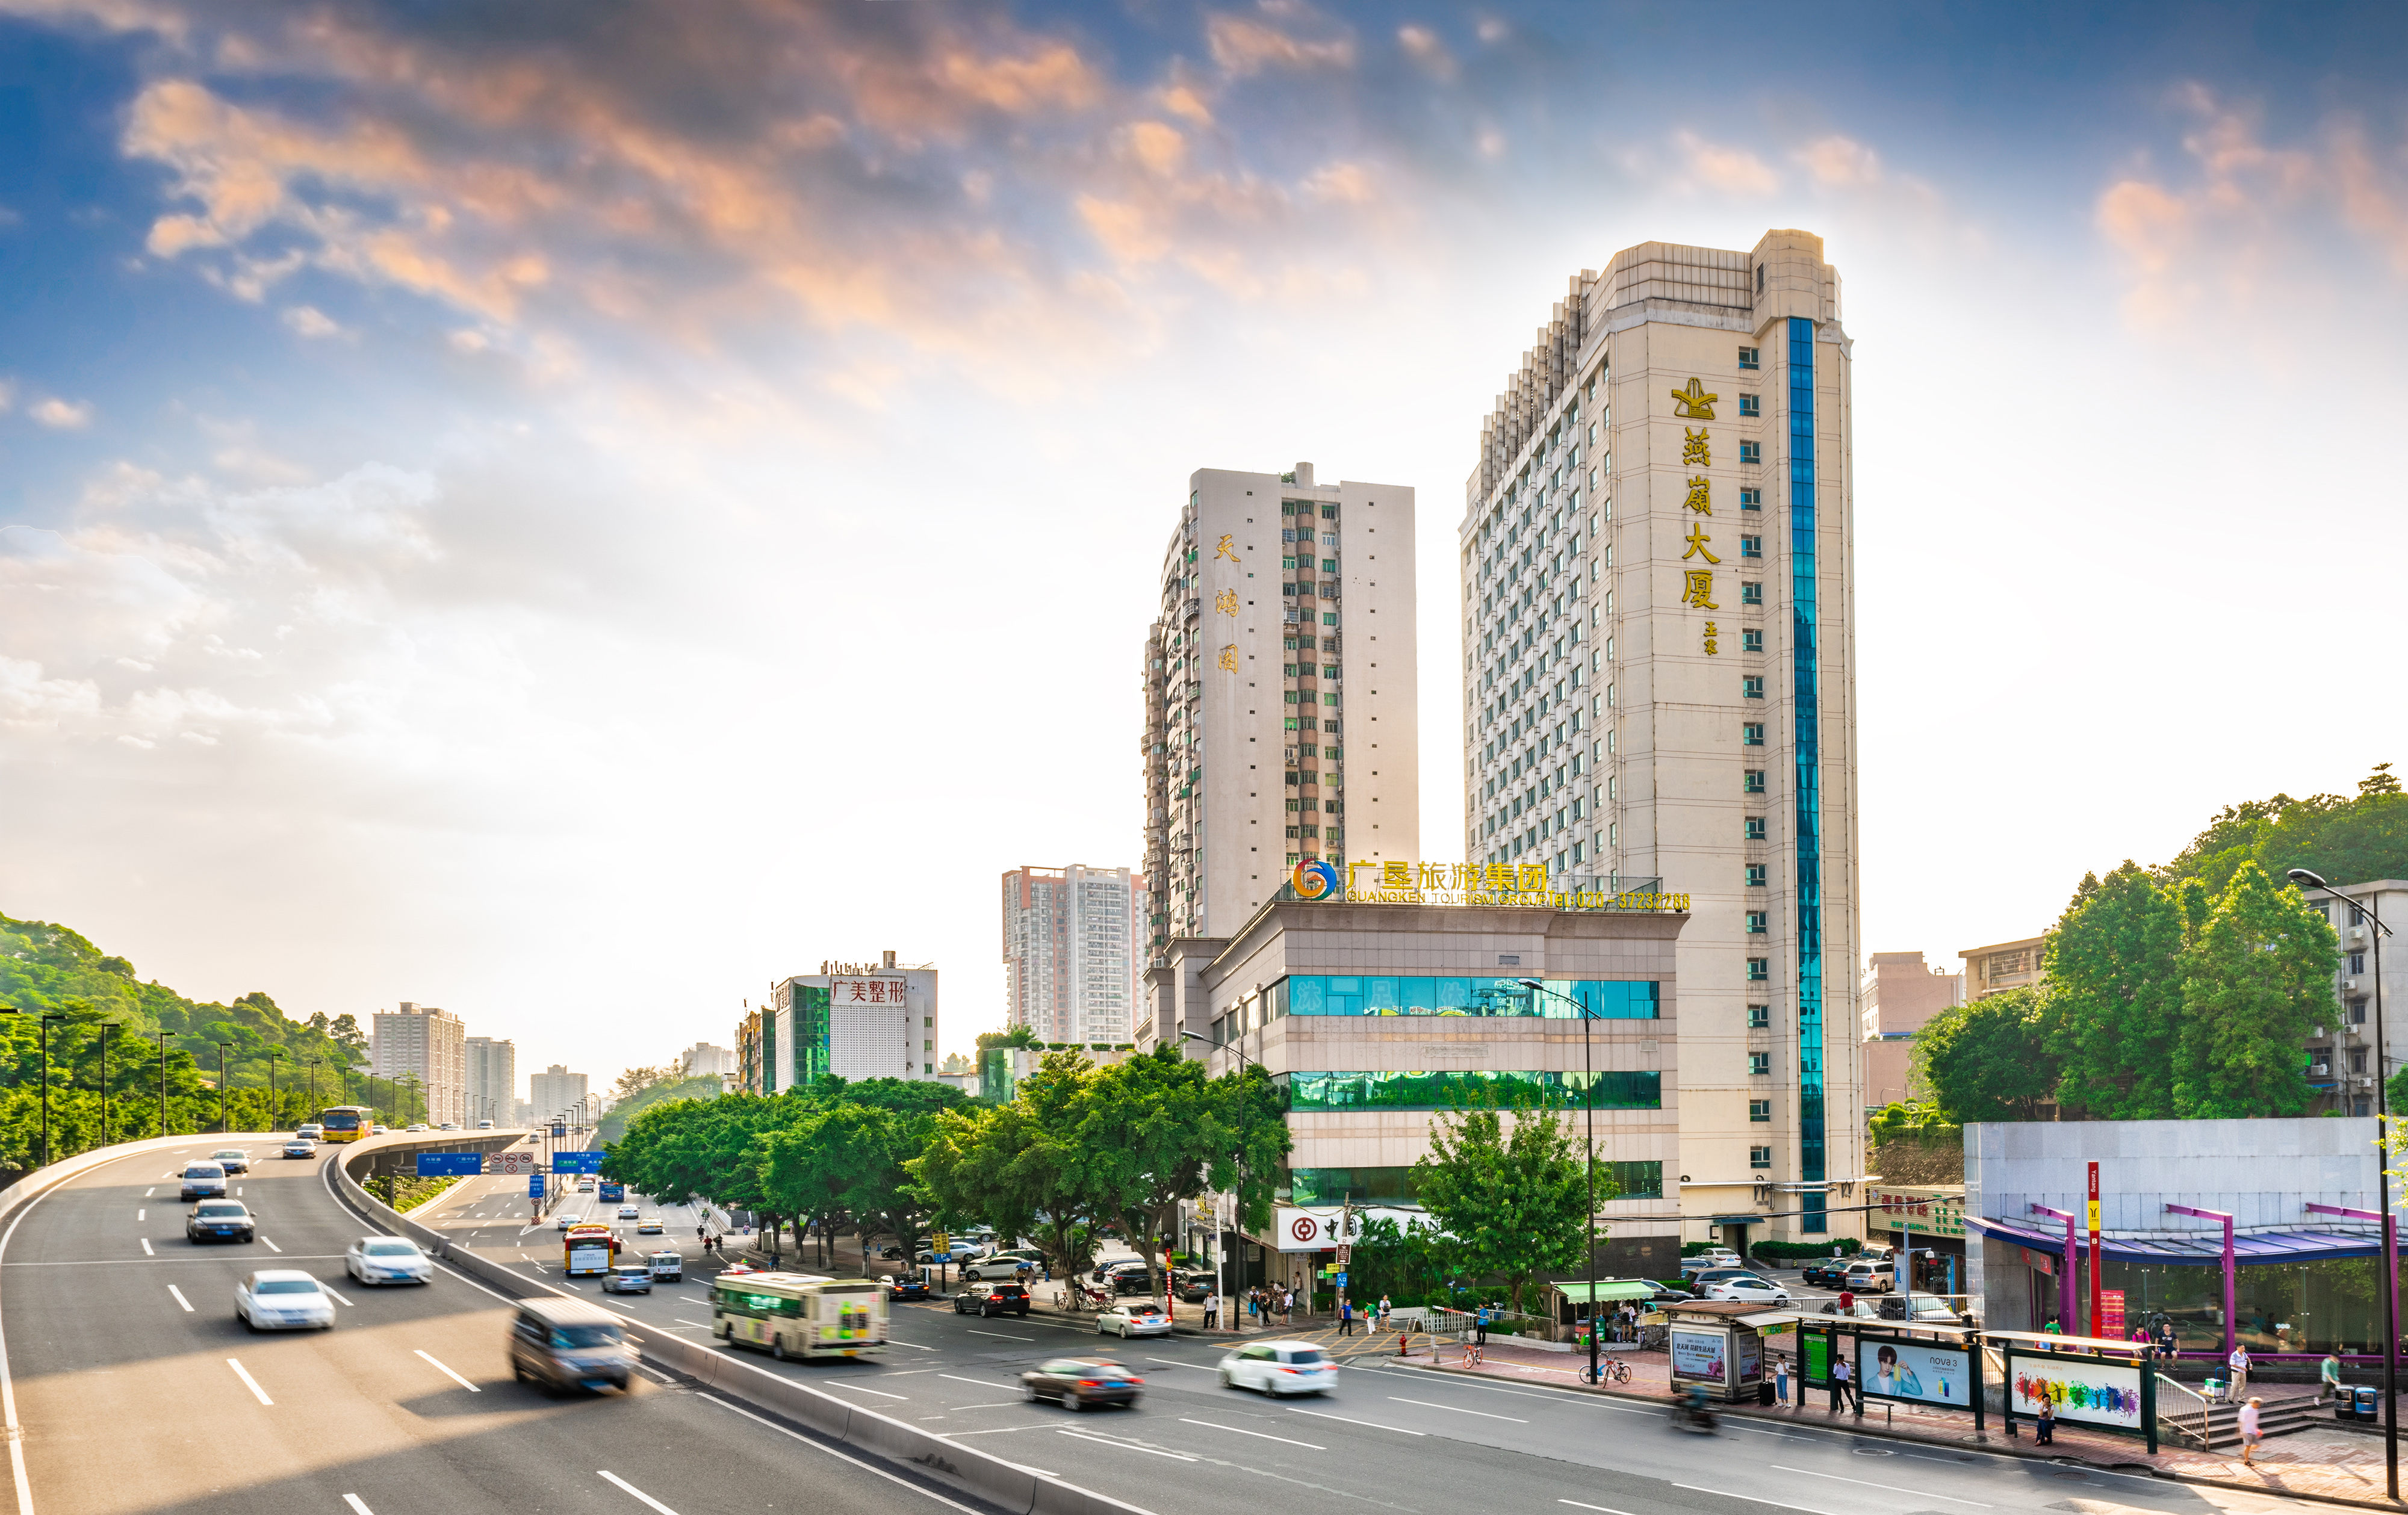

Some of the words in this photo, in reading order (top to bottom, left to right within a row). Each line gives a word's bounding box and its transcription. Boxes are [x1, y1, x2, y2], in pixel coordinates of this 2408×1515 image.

[1346, 859, 1547, 892] 广垦旅游集团
[1346, 890, 1426, 902] GUANGKEN
[1432, 892, 1494, 904] TOURISM
[1498, 893, 1547, 906] GROUP
[831, 979, 904, 1003] 广美整形
[1929, 1356, 1951, 1366] nova
